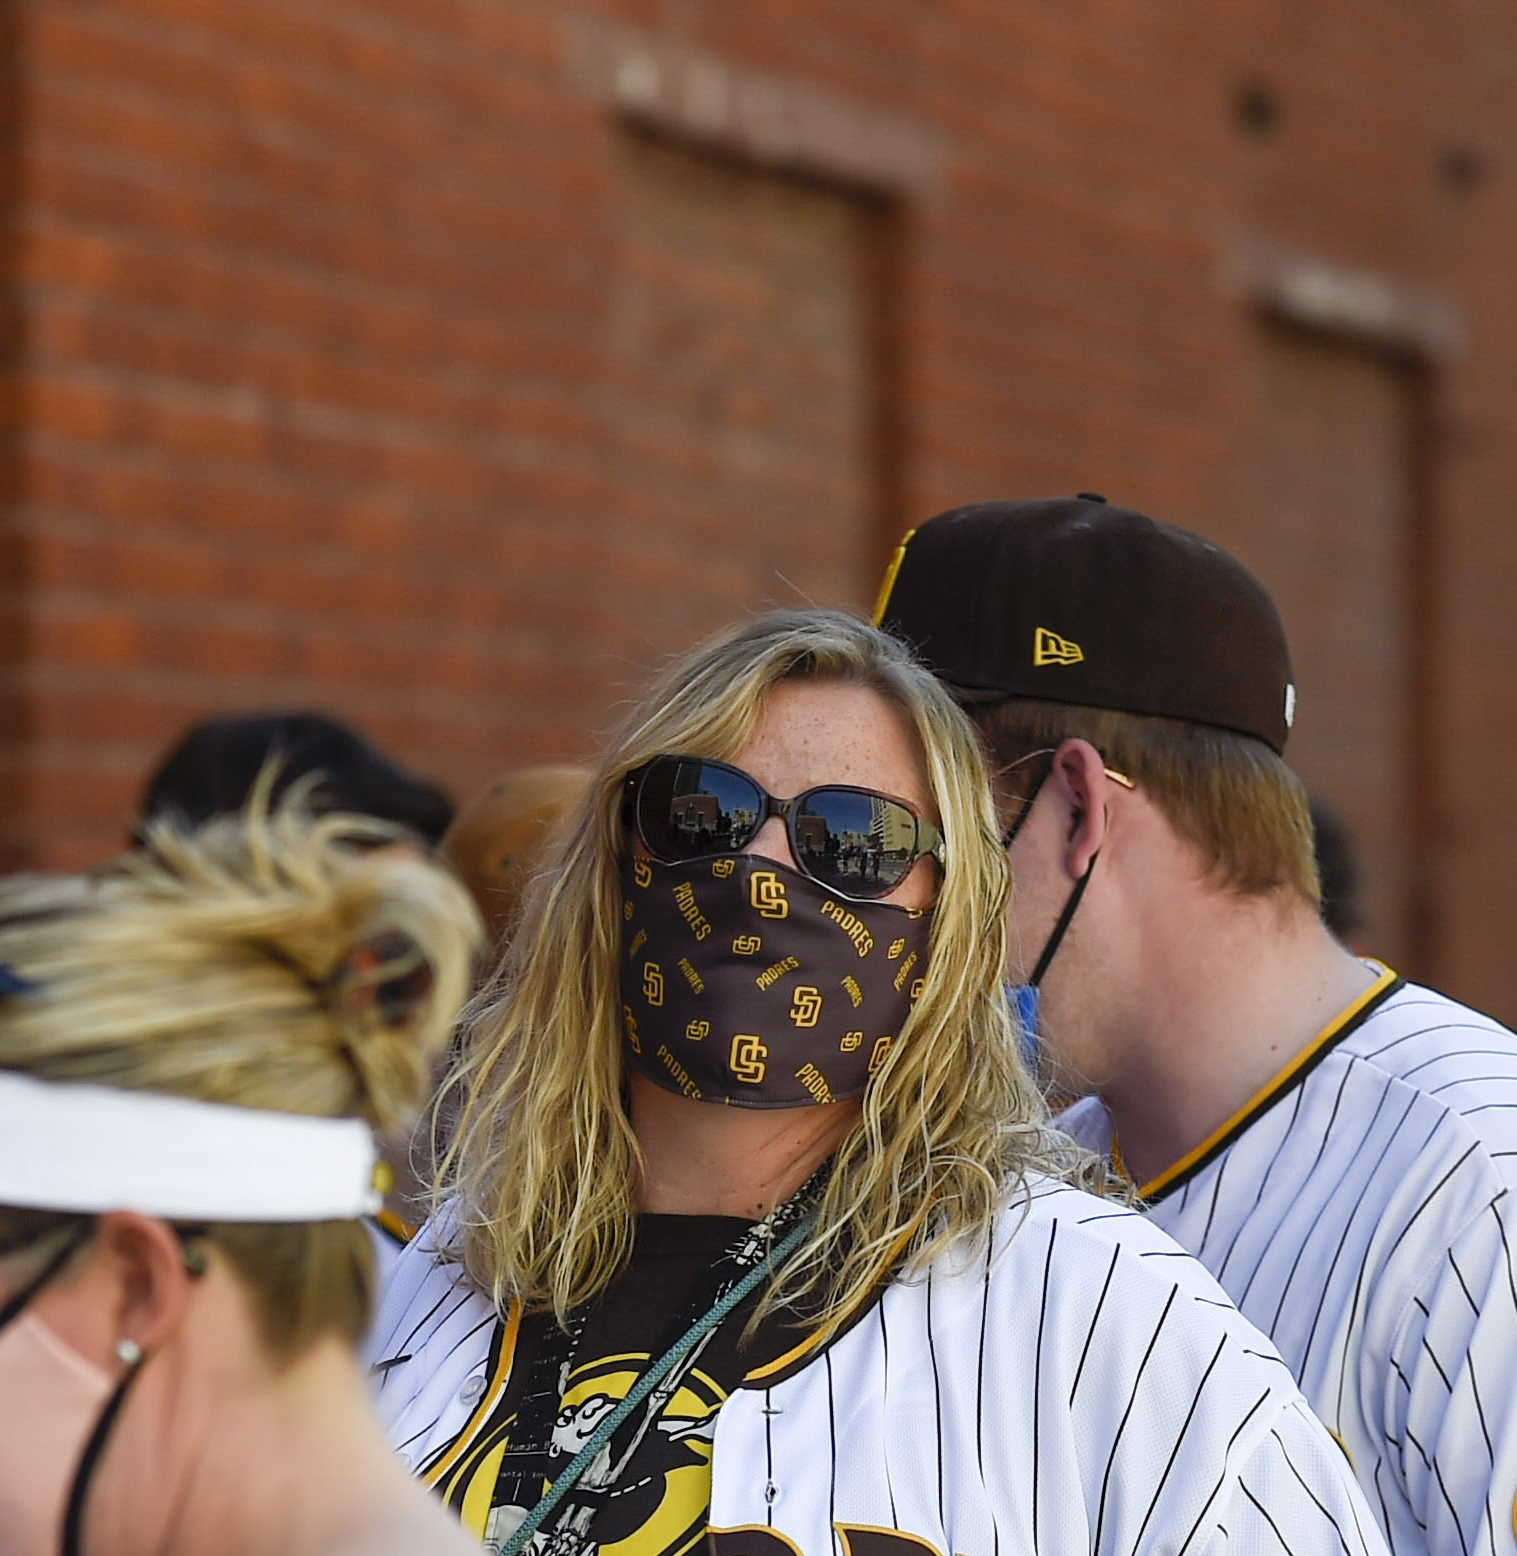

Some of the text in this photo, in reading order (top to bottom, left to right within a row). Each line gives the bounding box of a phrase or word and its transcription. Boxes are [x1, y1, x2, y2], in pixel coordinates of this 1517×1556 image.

[672, 881, 712, 942] PADRES
[820, 900, 874, 958] PADRES
[677, 957, 705, 995] PADRES
[754, 956, 800, 992] PADRES
[840, 975, 864, 1008] PADRES
[893, 951, 918, 992] PADRES
[790, 985, 823, 1028] SD
[657, 1044, 702, 1101] PADRES
